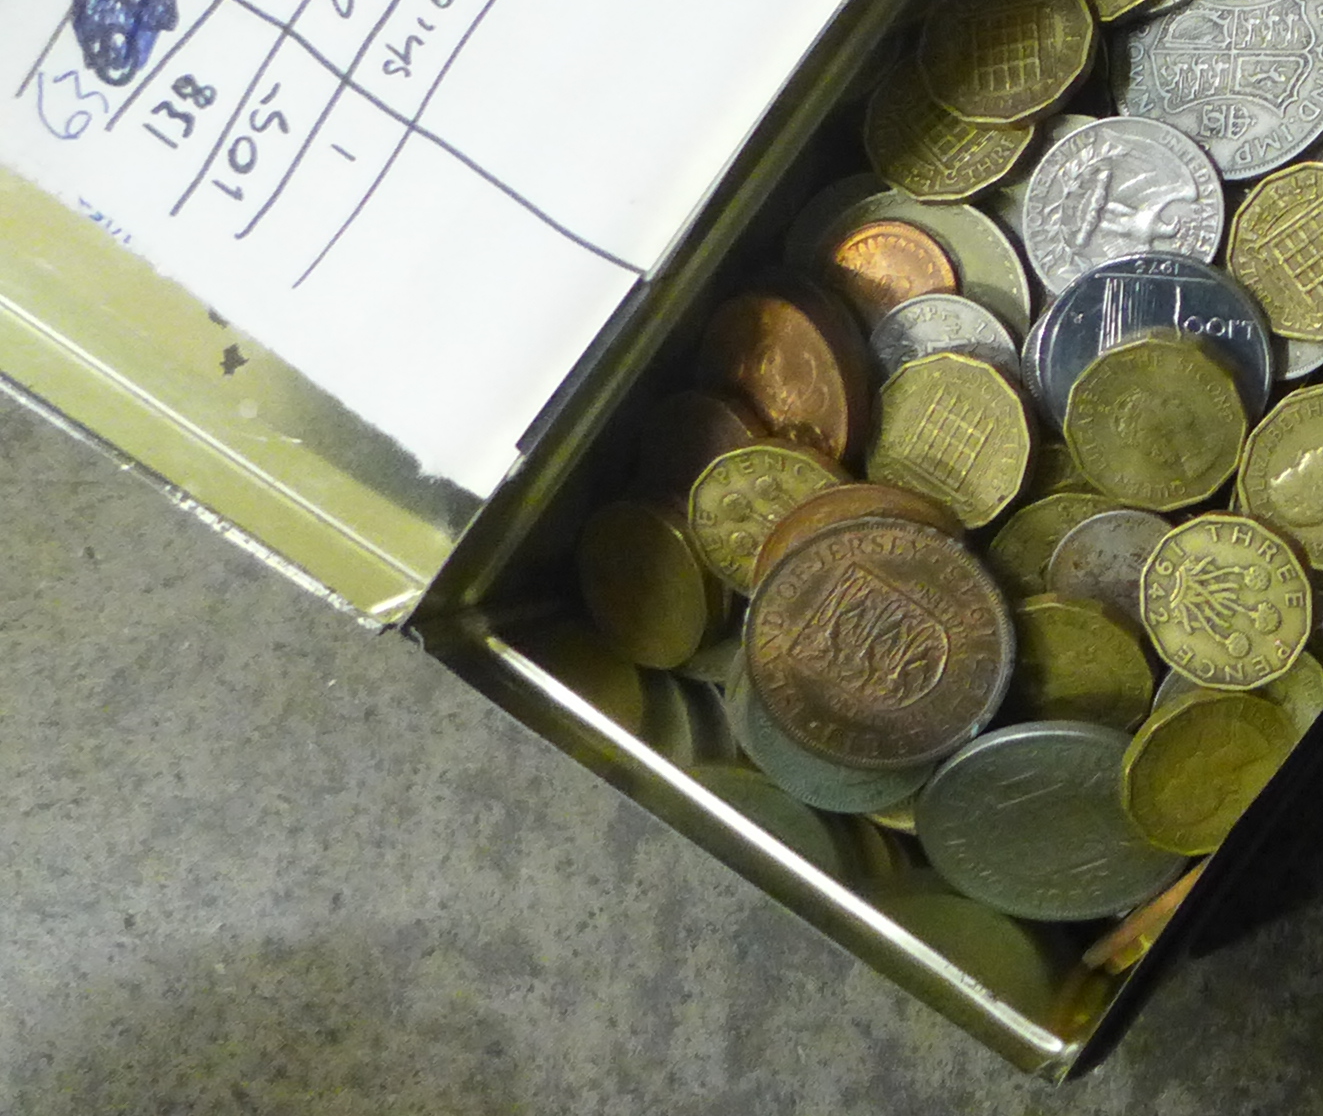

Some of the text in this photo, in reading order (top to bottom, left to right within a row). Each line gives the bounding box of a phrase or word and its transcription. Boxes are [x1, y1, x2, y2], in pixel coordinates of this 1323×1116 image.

[37, 69, 110, 141] 63
[143, 73, 217, 149] 138
[813, 532, 930, 570] JERSEY
[1147, 540, 1186, 625] 1942
[1204, 524, 1304, 608] THREE
[1175, 638, 1293, 681] PENCE
